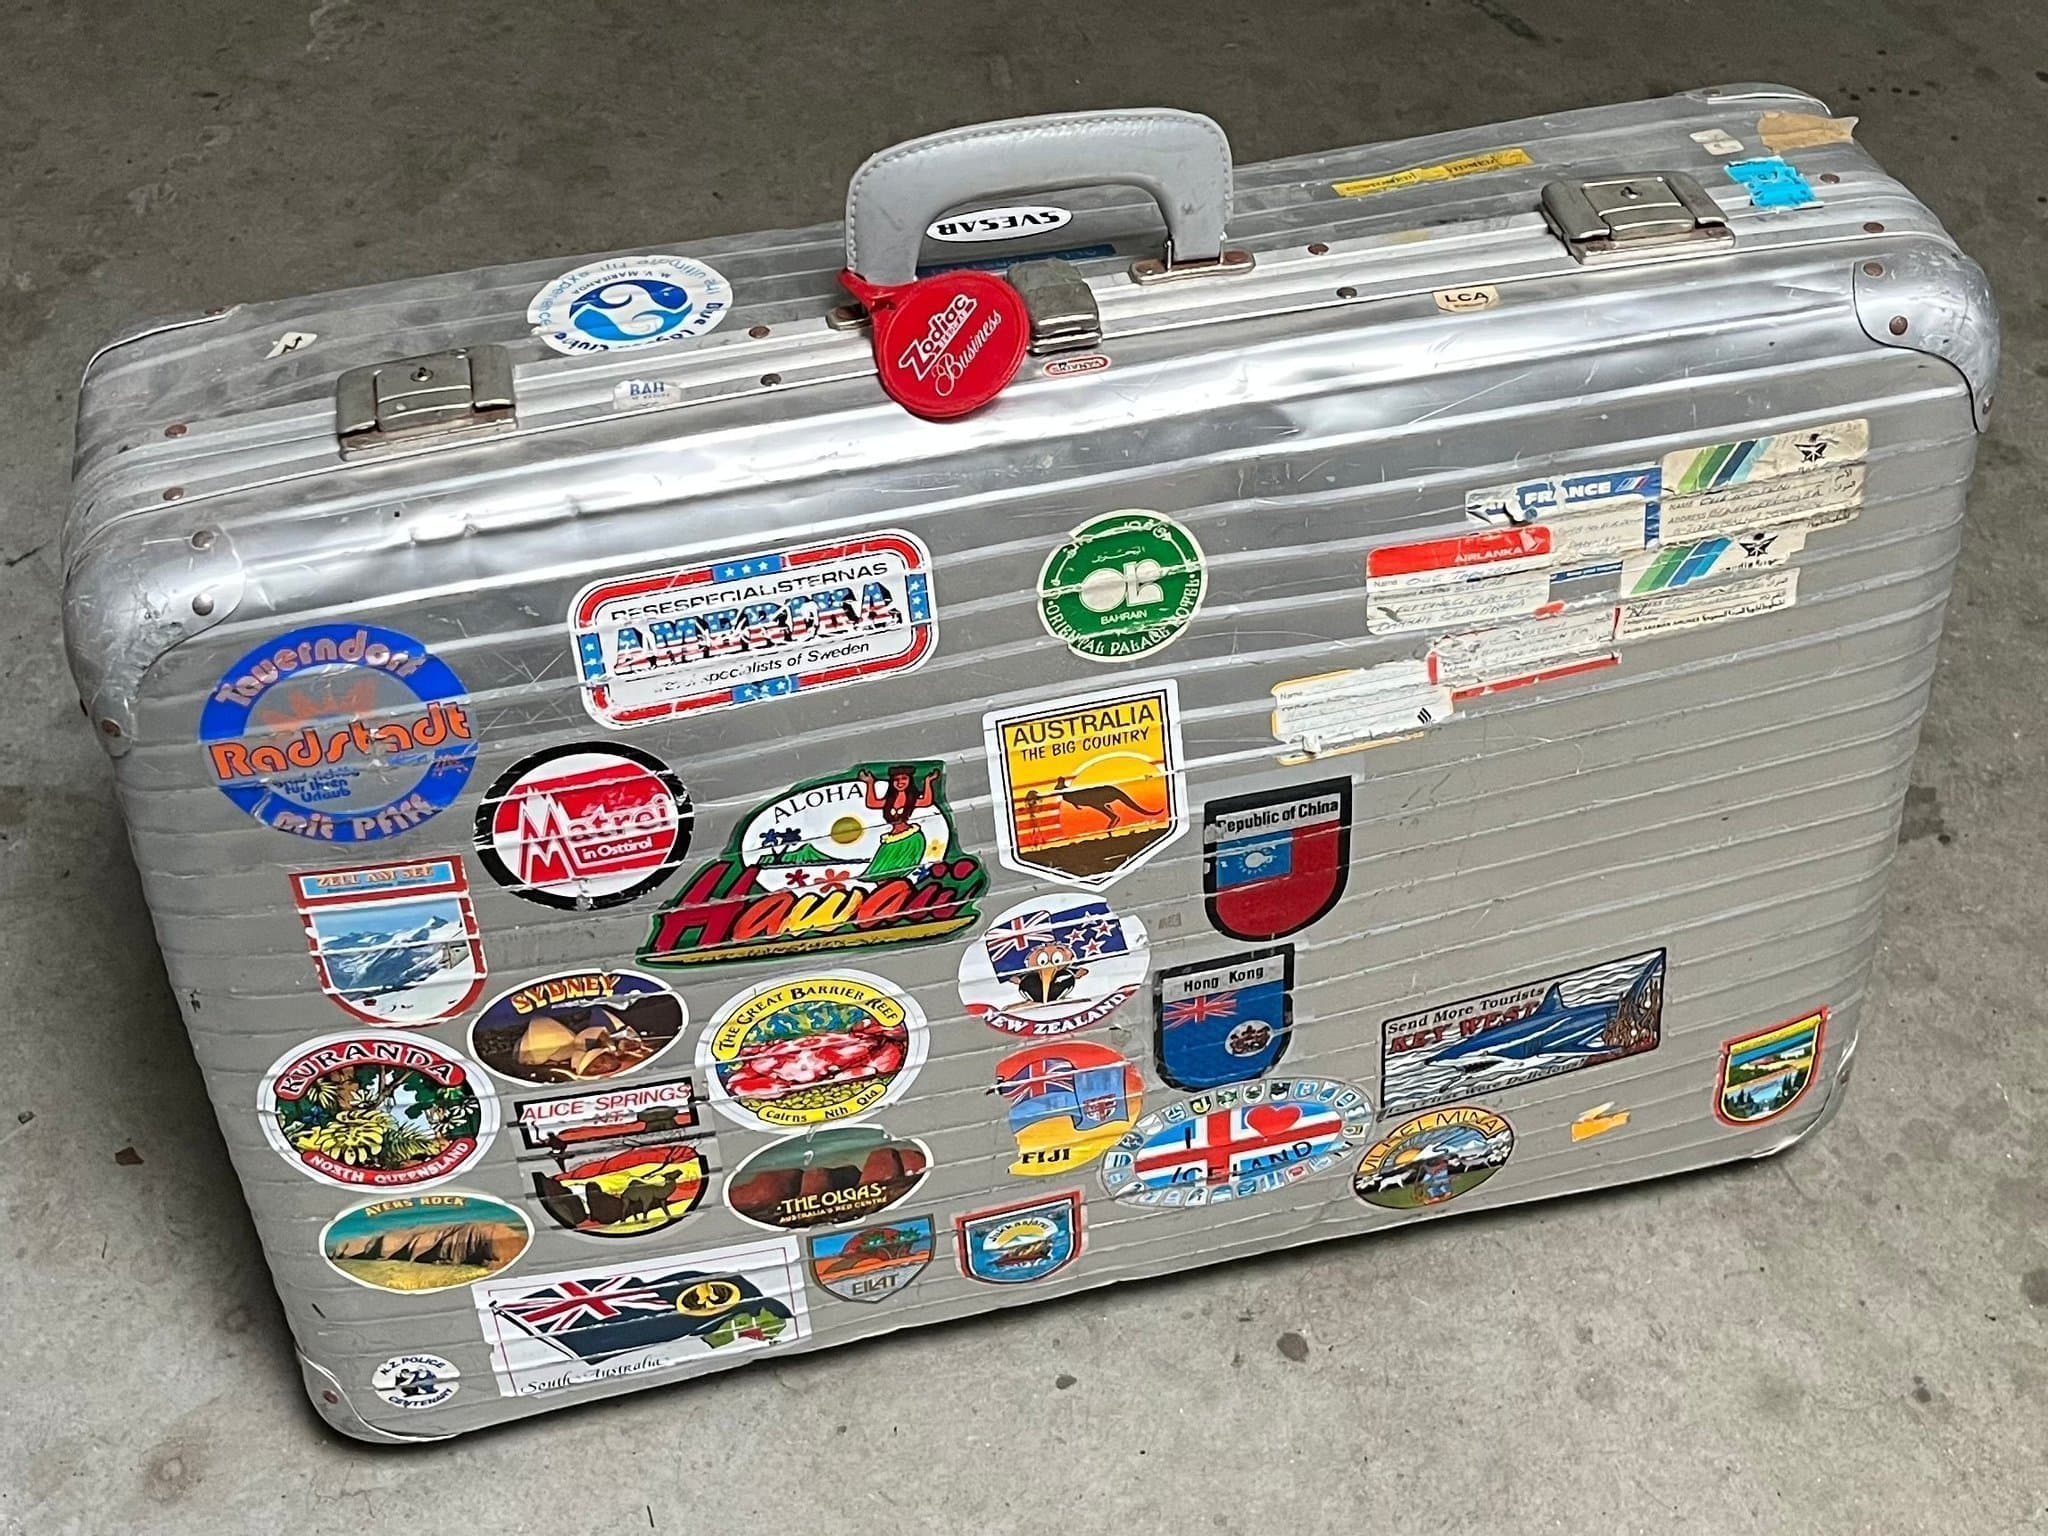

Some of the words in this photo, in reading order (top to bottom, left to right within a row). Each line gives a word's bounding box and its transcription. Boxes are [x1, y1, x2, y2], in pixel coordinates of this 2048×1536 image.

[937, 211, 1060, 235] SVESAR
[1444, 292, 1489, 304] LCA
[899, 294, 977, 381] Zodiac
[931, 309, 1002, 397] Business
[630, 380, 665, 395] BAH
[1525, 482, 1611, 505] FRANCE
[1455, 546, 1523, 563] AIRLANKA
[610, 562, 888, 622] RESESPECIALISTERNAS
[1374, 578, 1398, 587] Name
[1046, 604, 1105, 655] ORIENTAL
[1110, 627, 1171, 655] PALACE
[1100, 609, 1148, 625] BAHRAIN
[786, 653, 803, 667] of
[807, 641, 870, 663] Sweden
[209, 702, 472, 780] Radstadt
[1012, 704, 1155, 747] AUSTRALIA
[1020, 747, 1046, 762] THE
[1052, 740, 1076, 757] BIG
[1082, 727, 1150, 750] COUNTRY
[774, 783, 865, 825] ALOHA
[1282, 805, 1297, 822] of
[1298, 800, 1340, 819] China
[519, 787, 673, 885] Matrei
[583, 847, 597, 860] in
[600, 837, 654, 856] Osttirol
[654, 858, 978, 955] Hawaii
[511, 975, 622, 1015] SYDNEY
[1184, 977, 1220, 993] Hong
[1228, 966, 1265, 984] Kong
[718, 1026, 740, 1051] THE
[737, 993, 783, 1025] GREAT
[791, 984, 866, 1001] BARRIER
[865, 998, 899, 1021] REEF
[982, 1010, 1030, 1032] NEW
[1033, 993, 1127, 1035] ZEALAND
[1388, 1014, 1428, 1034] Send
[1432, 1004, 1475, 1025] More
[1479, 985, 1546, 1011] Tourists
[1458, 1000, 1541, 1037] WEST
[281, 1042, 454, 1095] KURANDA
[521, 1101, 585, 1122] ALICE
[594, 1084, 692, 1111] SPRINGS
[765, 1109, 808, 1123] Cairns
[1020, 1148, 1071, 1164] FIJI
[1364, 1110, 1499, 1170] VILHELMINA
[310, 1155, 365, 1182] NORTH
[374, 1141, 469, 1184] QUEENSLAND
[1171, 1141, 1313, 1184] ICELAND
[364, 1198, 414, 1217] AYERS
[420, 1195, 466, 1207] ROCK
[780, 1194, 820, 1214] THE
[821, 1182, 882, 1205] OLGAS
[854, 1196, 887, 1209] CENTRE
[852, 1273, 898, 1296] EILAT
[401, 1356, 446, 1369] POLICE
[520, 1373, 574, 1396] South
[585, 1355, 671, 1380] Australia
